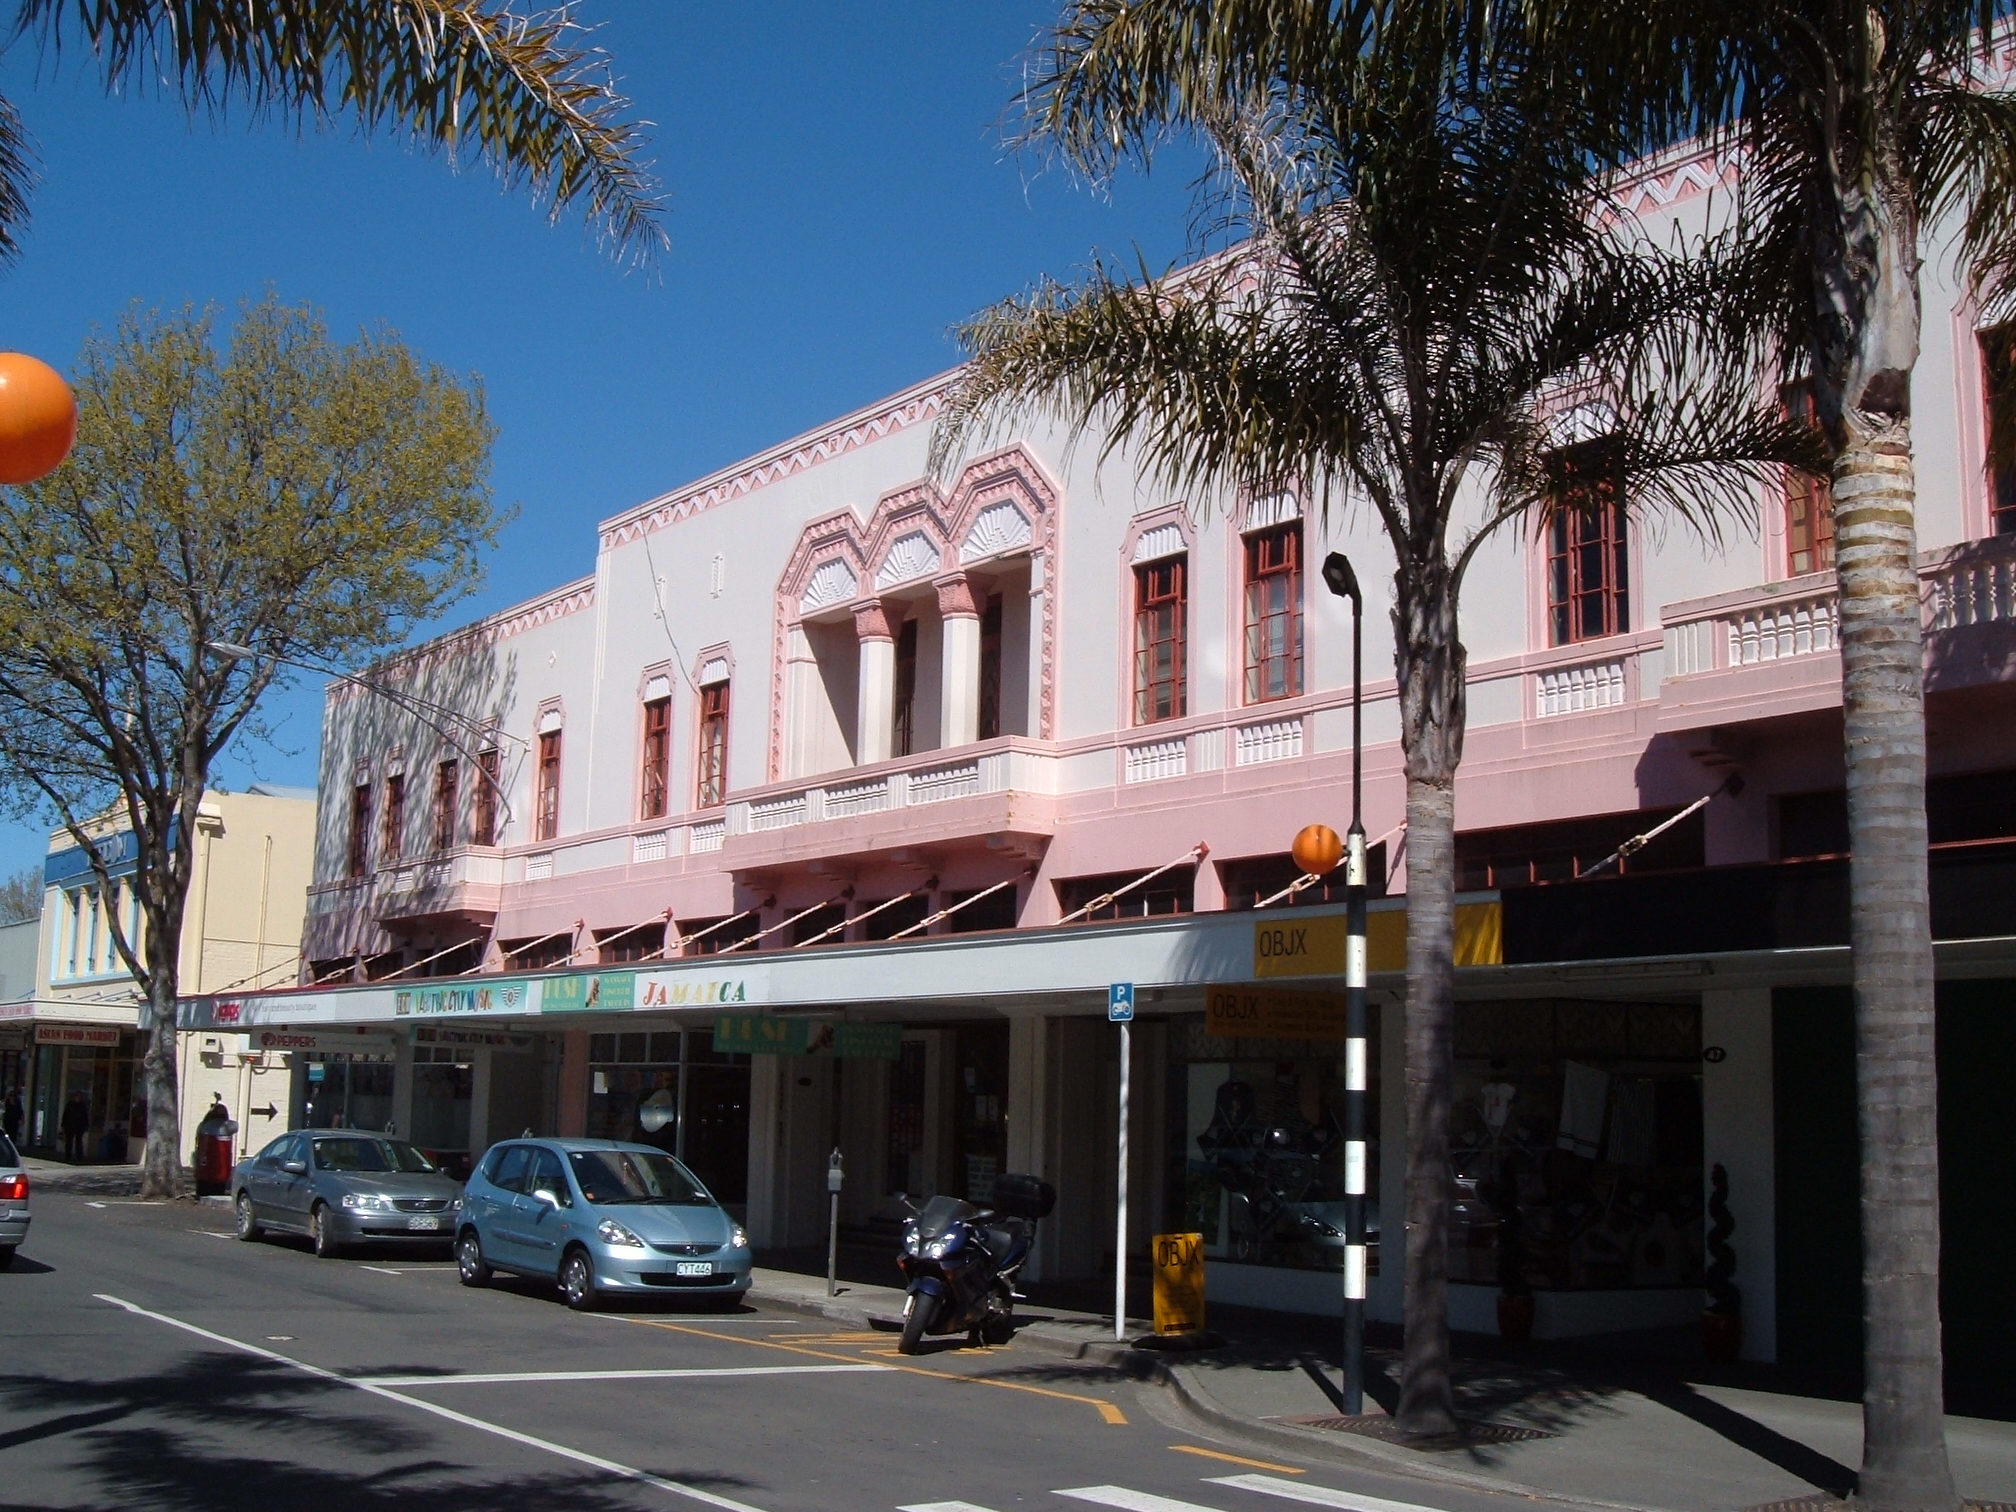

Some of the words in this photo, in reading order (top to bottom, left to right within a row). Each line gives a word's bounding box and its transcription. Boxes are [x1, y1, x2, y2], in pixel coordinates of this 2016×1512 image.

[1259, 928, 1307, 957] OBJX
[643, 979, 746, 1006] JAMAICA
[1116, 986, 1126, 1000] P
[1213, 993, 1260, 1020] OBJX
[63, 1029, 84, 1041] FOOD
[276, 1034, 317, 1048] PEPPERS
[1158, 1240, 1200, 1268] OBJX
[678, 1263, 710, 1274] CYT446
